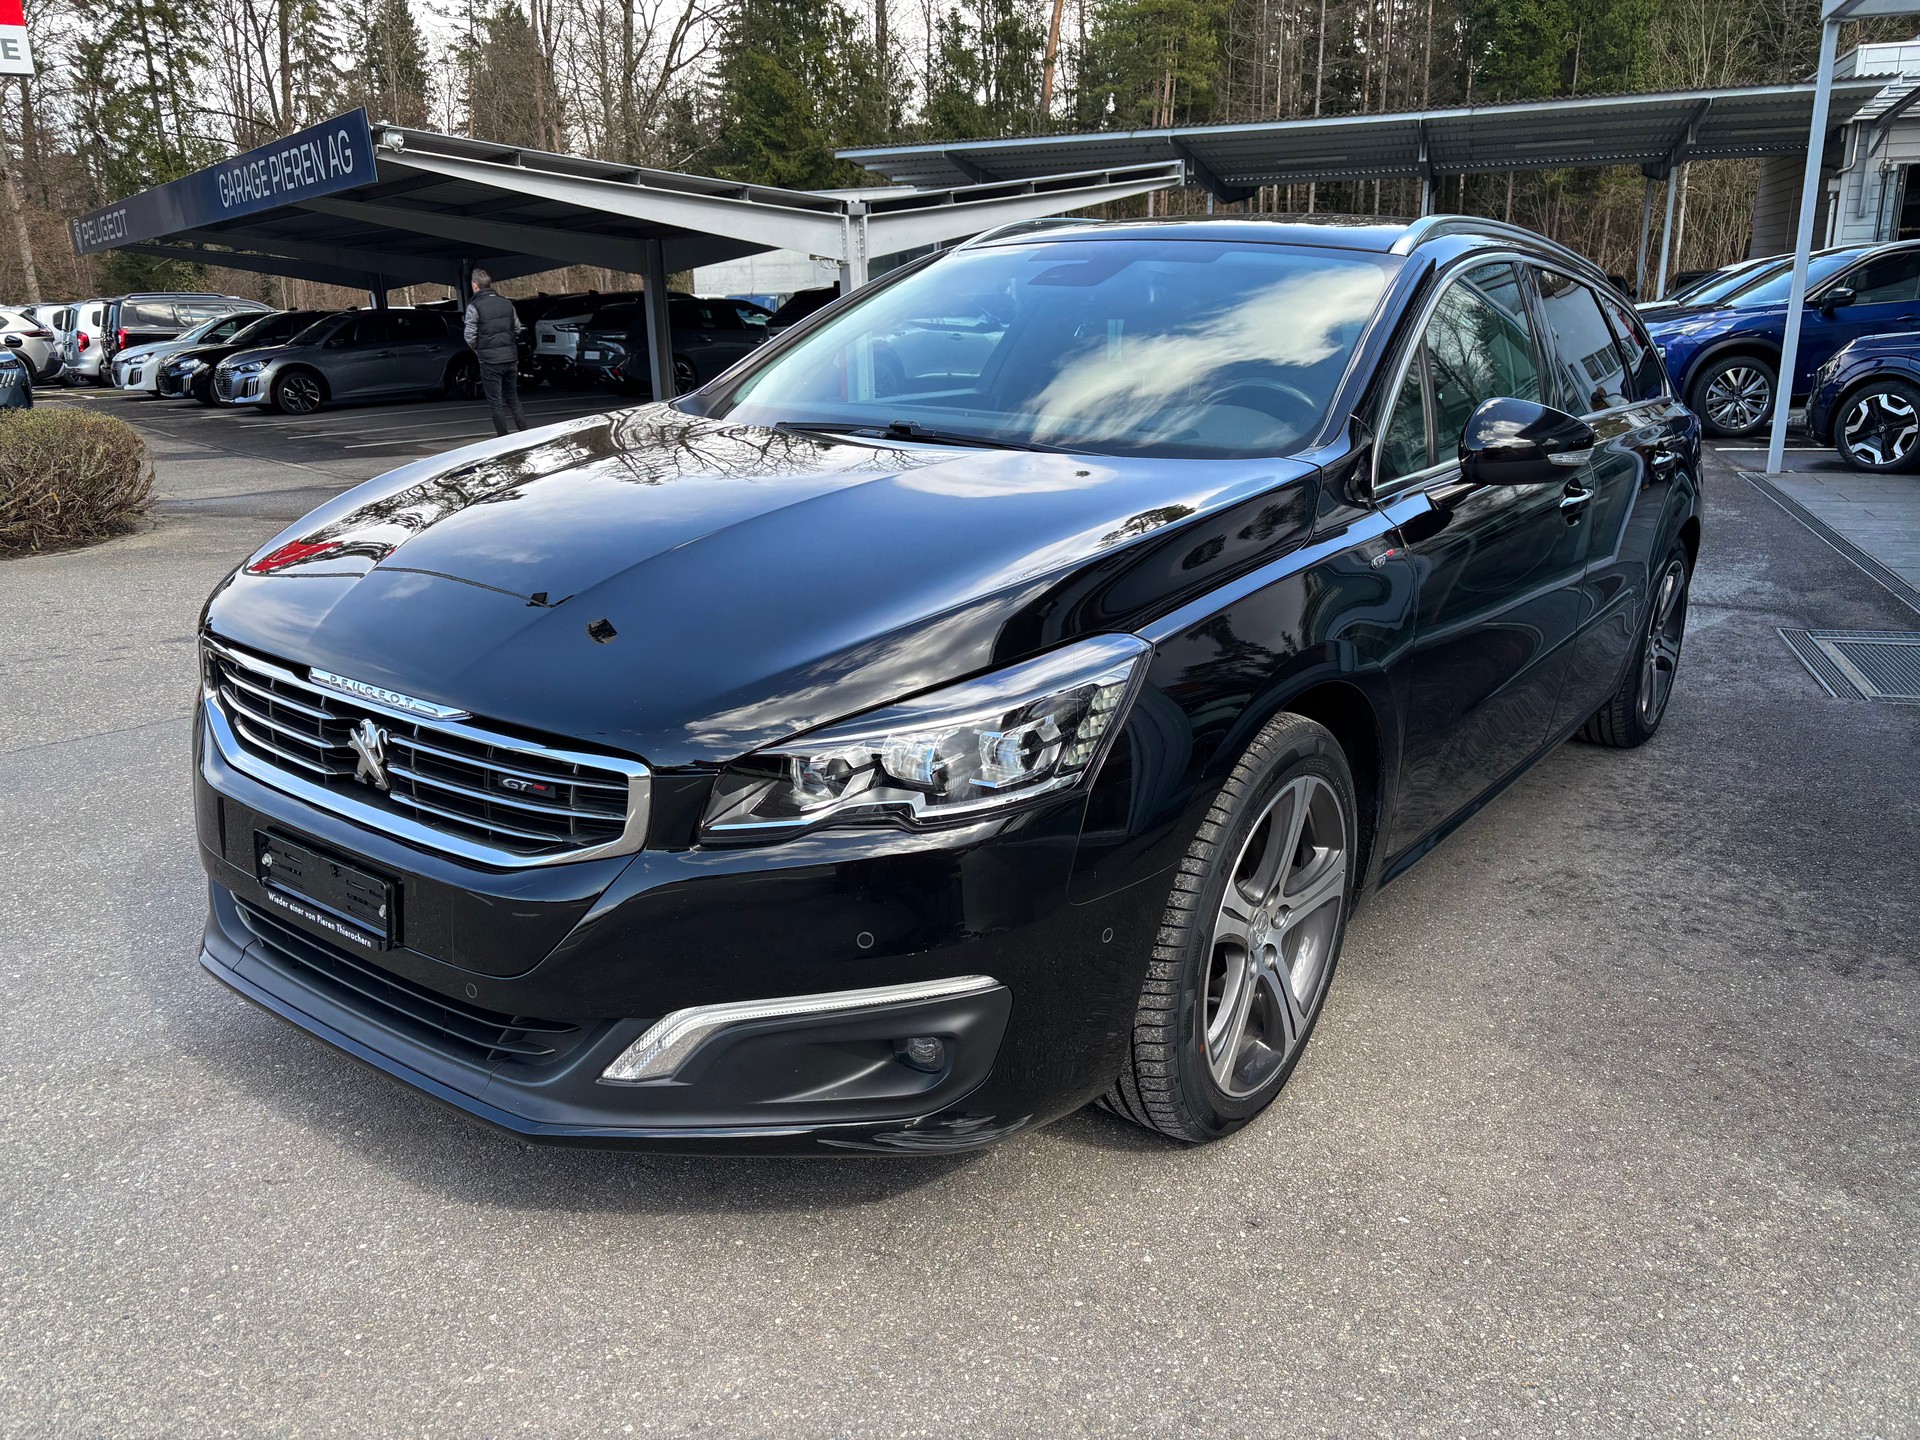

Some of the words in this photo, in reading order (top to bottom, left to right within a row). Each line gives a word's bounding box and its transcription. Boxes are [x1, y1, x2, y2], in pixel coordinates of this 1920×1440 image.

[218, 159, 271, 208] GARAGE
[269, 139, 326, 194] PIEREN
[328, 129, 353, 178] AG
[81, 208, 128, 247] PEUGEOT
[329, 674, 414, 709] PEUGEOT
[502, 778, 533, 791] GT
[267, 891, 288, 908] Wieder
[289, 903, 304, 915] einer
[304, 911, 316, 922] von
[316, 914, 335, 931] Pieren
[336, 923, 372, 948] Thierachern
